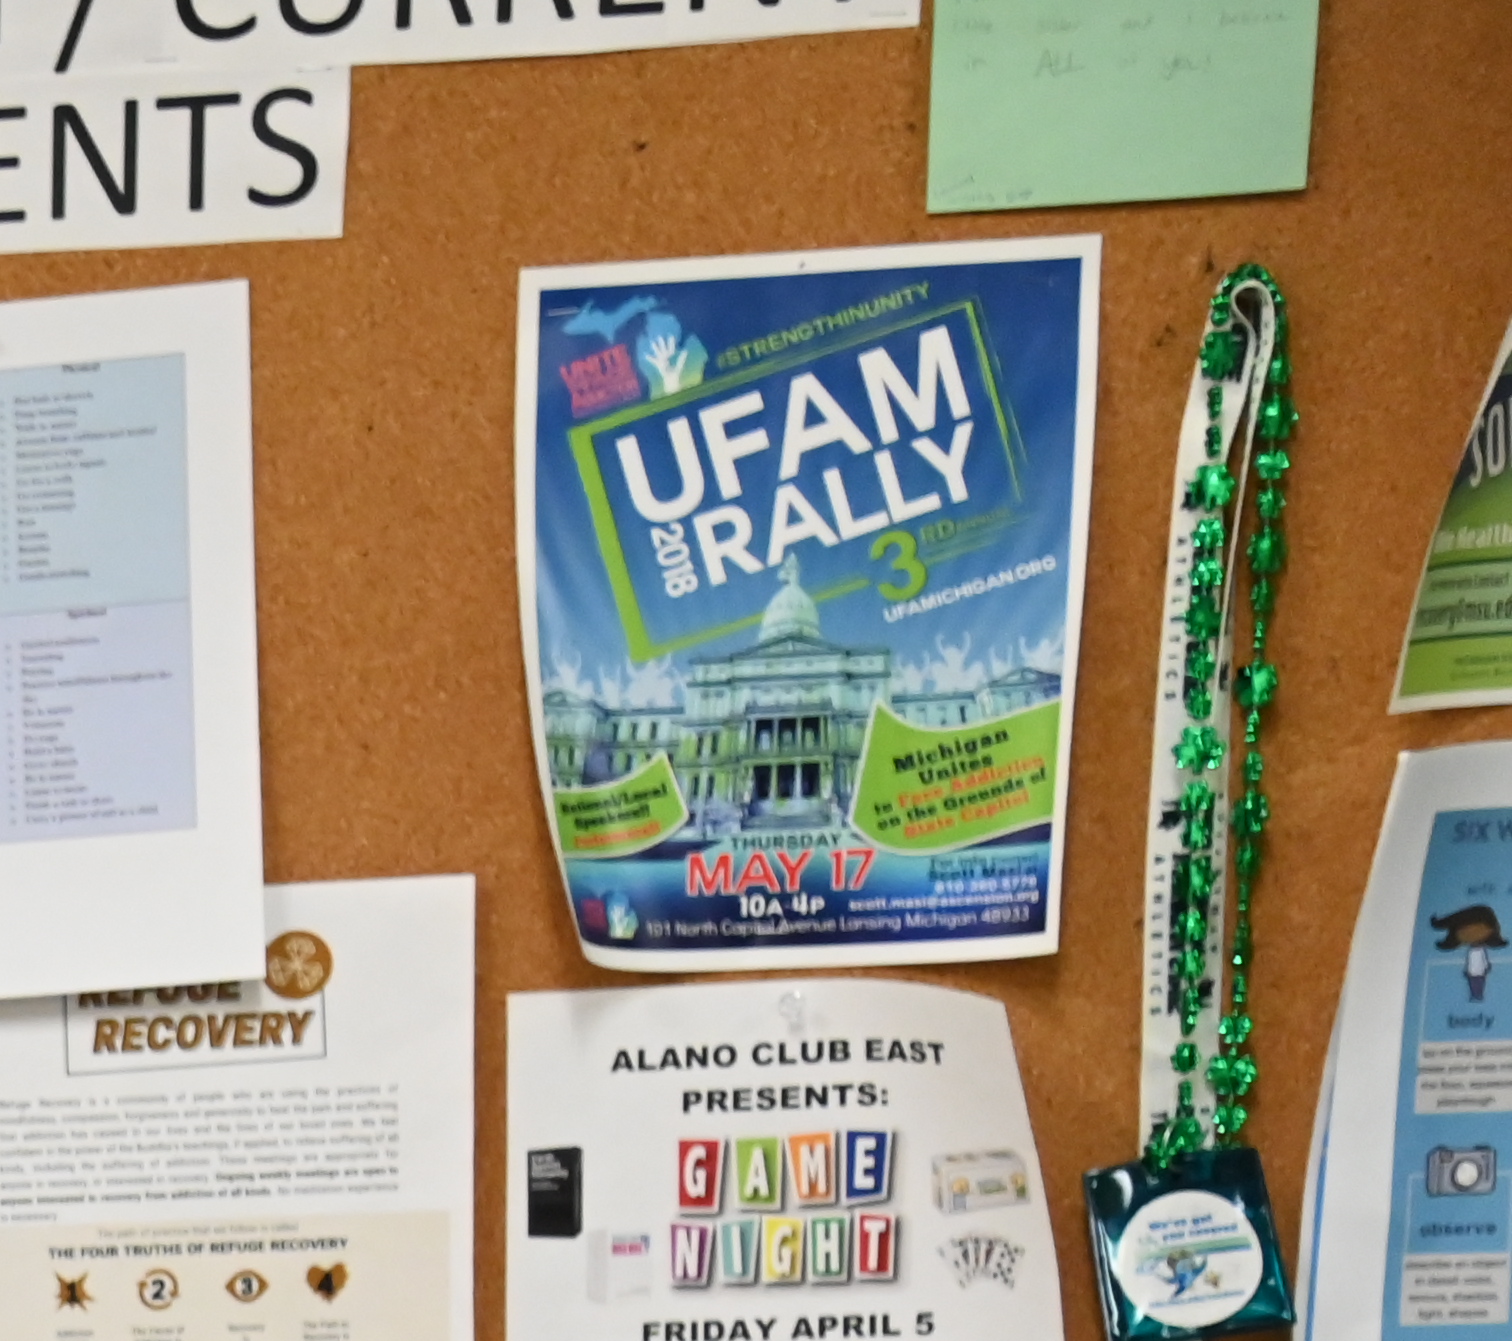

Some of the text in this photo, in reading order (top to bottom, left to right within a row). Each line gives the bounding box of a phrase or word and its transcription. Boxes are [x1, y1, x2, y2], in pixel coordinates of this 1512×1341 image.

[716, 279, 931, 371] #STRENGTHINUNITY
[615, 323, 973, 524] UFAM
[650, 418, 975, 600] 2018 RALLY
[869, 527, 930, 602] 3
[881, 553, 1057, 624] UFAMICHIGAN.ORG
[892, 728, 1010, 774] Michigan
[918, 754, 995, 786] Unites
[877, 815, 902, 831] on
[906, 803, 938, 822] the
[731, 831, 842, 851] THURSDAY
[685, 848, 814, 897] MAY
[830, 846, 879, 892] 17
[92, 1009, 316, 1055] RECOVERY
[1447, 1010, 1495, 1031] body
[611, 1037, 946, 1074] ALANO CLUB EAST
[681, 1082, 890, 1115] PRESENTS:
[678, 1132, 892, 1208] GAME
[48, 1237, 349, 1260] THE FOUR TRUTHS OF REFUGE RECOVERY
[1419, 1219, 1498, 1239] observe
[670, 1216, 894, 1290] NIGHT
[150, 1279, 167, 1301] 2
[240, 1276, 255, 1297] 3
[316, 1271, 336, 1296] 4
[792, 1312, 902, 1341] APRIL
[914, 1311, 937, 1337] 5
